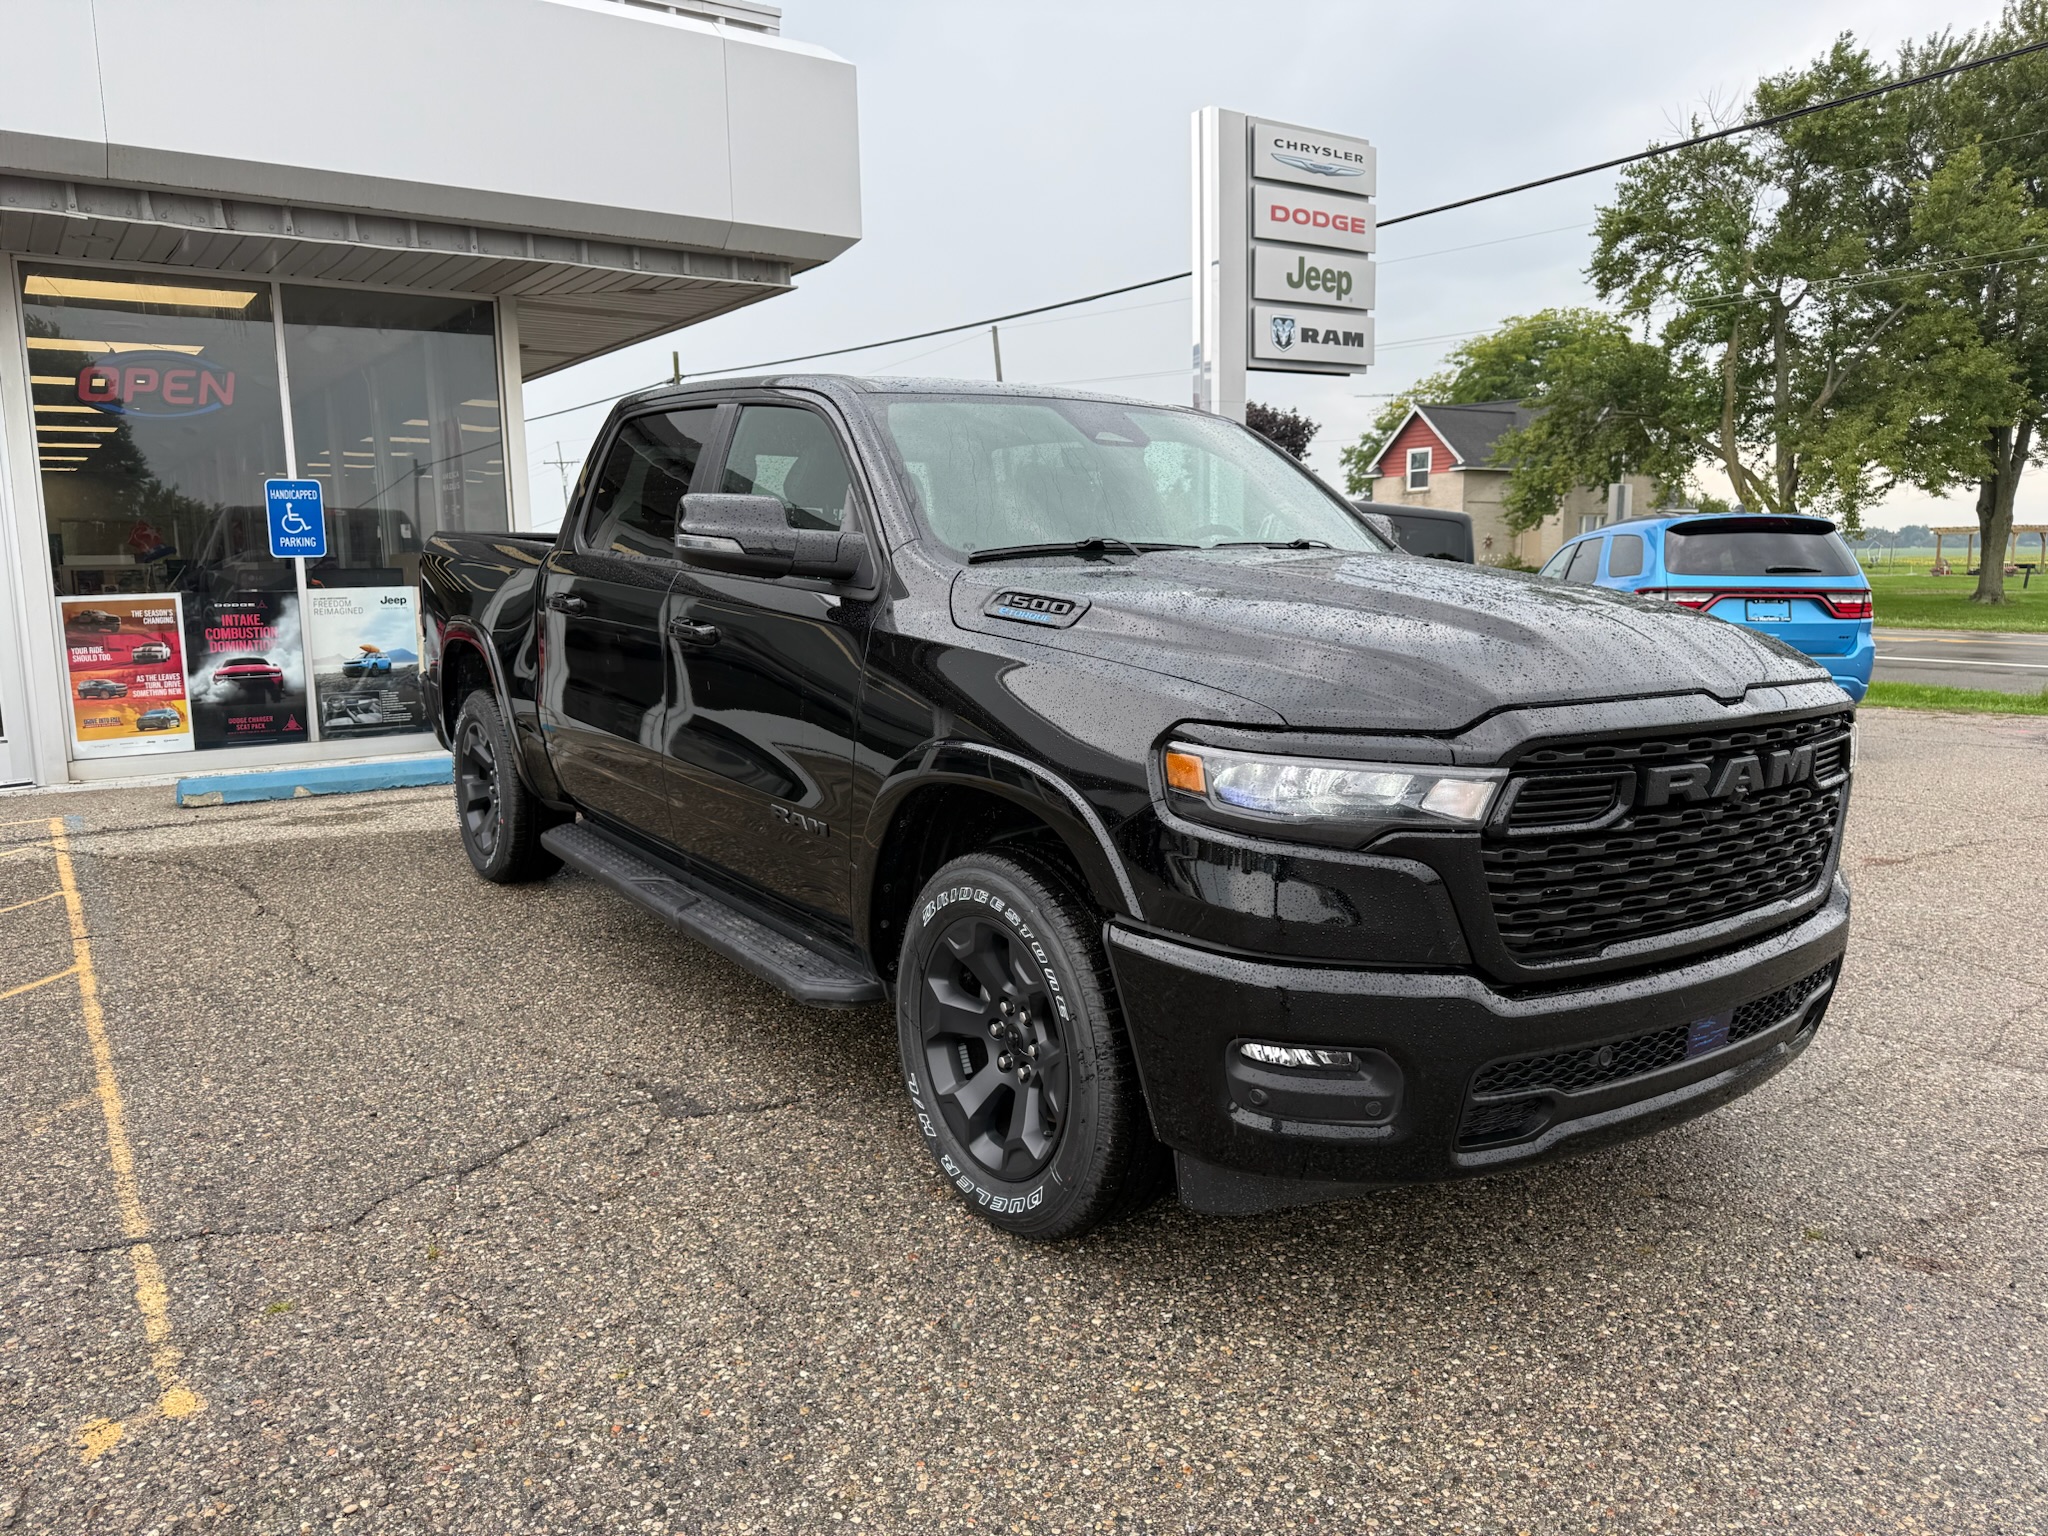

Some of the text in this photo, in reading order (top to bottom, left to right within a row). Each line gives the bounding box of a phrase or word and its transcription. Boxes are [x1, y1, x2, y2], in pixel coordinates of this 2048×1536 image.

[1273, 138, 1364, 164] CHRYSLER
[1270, 204, 1366, 234] DODGE
[1286, 255, 1353, 301] Jeep
[1300, 326, 1364, 348] RAM
[78, 366, 236, 406] OPEN
[269, 489, 318, 500] HANDICAPPED
[279, 536, 317, 548] PARKING
[312, 600, 352, 608] FREEDOM
[380, 595, 407, 605] Jeep
[1003, 594, 1071, 615] 1500
[131, 608, 174, 618] THE SEASON'S
[313, 607, 364, 616] REIMAGINED
[143, 616, 176, 625] CHANGING.
[221, 613, 264, 627] INTAKE.
[71, 646, 104, 655] YOUR RIDE
[72, 653, 113, 663] SHOULD TOO.
[136, 673, 181, 683] AS THE LEAVES
[132, 688, 184, 698] SOMETHING NEW.
[1643, 744, 1814, 807] RAM
[769, 803, 831, 838] RAM
[921, 886, 1070, 1023] BRIDGESTONE
[940, 1153, 1044, 1215] DUELER
